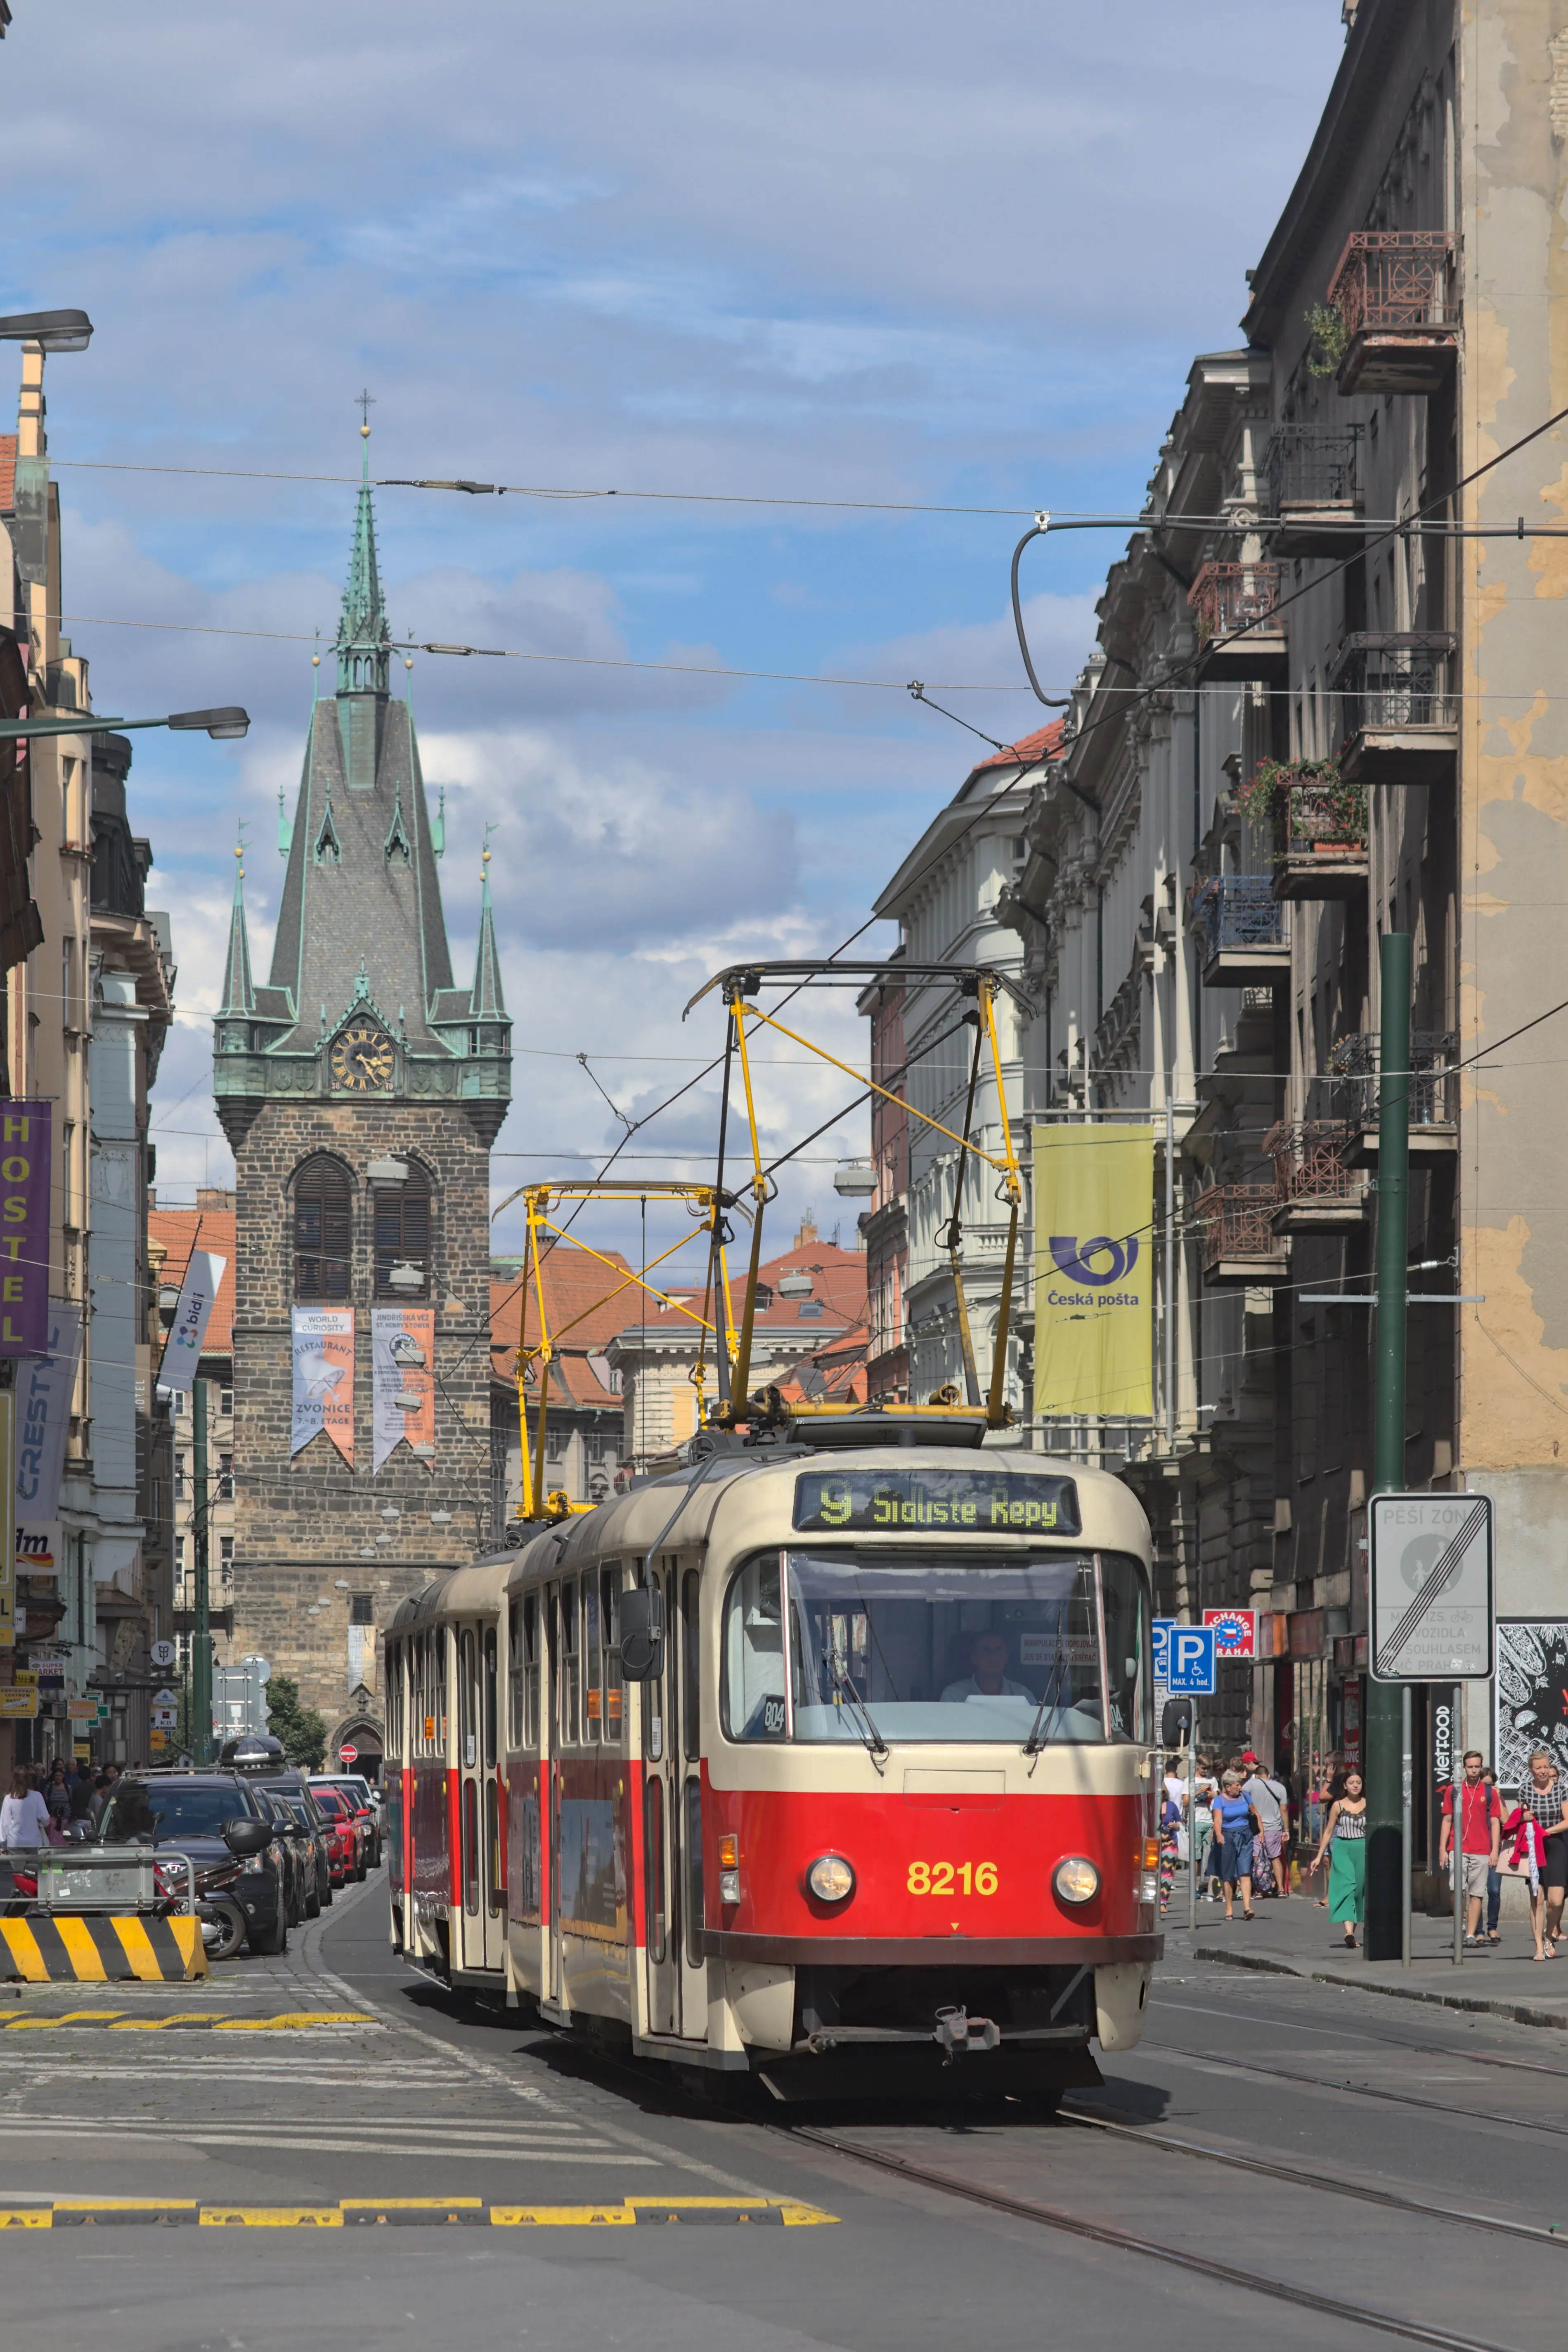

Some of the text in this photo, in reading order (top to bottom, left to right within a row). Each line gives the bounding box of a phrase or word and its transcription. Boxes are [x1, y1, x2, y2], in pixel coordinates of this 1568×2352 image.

[2, 1116, 30, 1342] HOSTEL
[1048, 1290, 1139, 1308] Česká pošta
[294, 1341, 352, 1356] RESTAURANT
[135, 1379, 145, 1412] HOTEL
[296, 1404, 350, 1413] ZVONICE
[820, 1479, 852, 1524] 9
[991, 1481, 1057, 1526] Řepy
[1384, 1505, 1471, 1524] PĚŠÍ ZÓN
[1426, 1611, 1447, 1622] IZS.
[1414, 1628, 1466, 1638] VOZIDLA
[1178, 1635, 1205, 1673] P
[1405, 1645, 1480, 1655] SOUHLASEM
[1395, 1659, 1455, 1671] MČ PRAH
[764, 1701, 785, 1728] 804
[1110, 1704, 1124, 1727] 04
[907, 1861, 998, 1895] 8216
